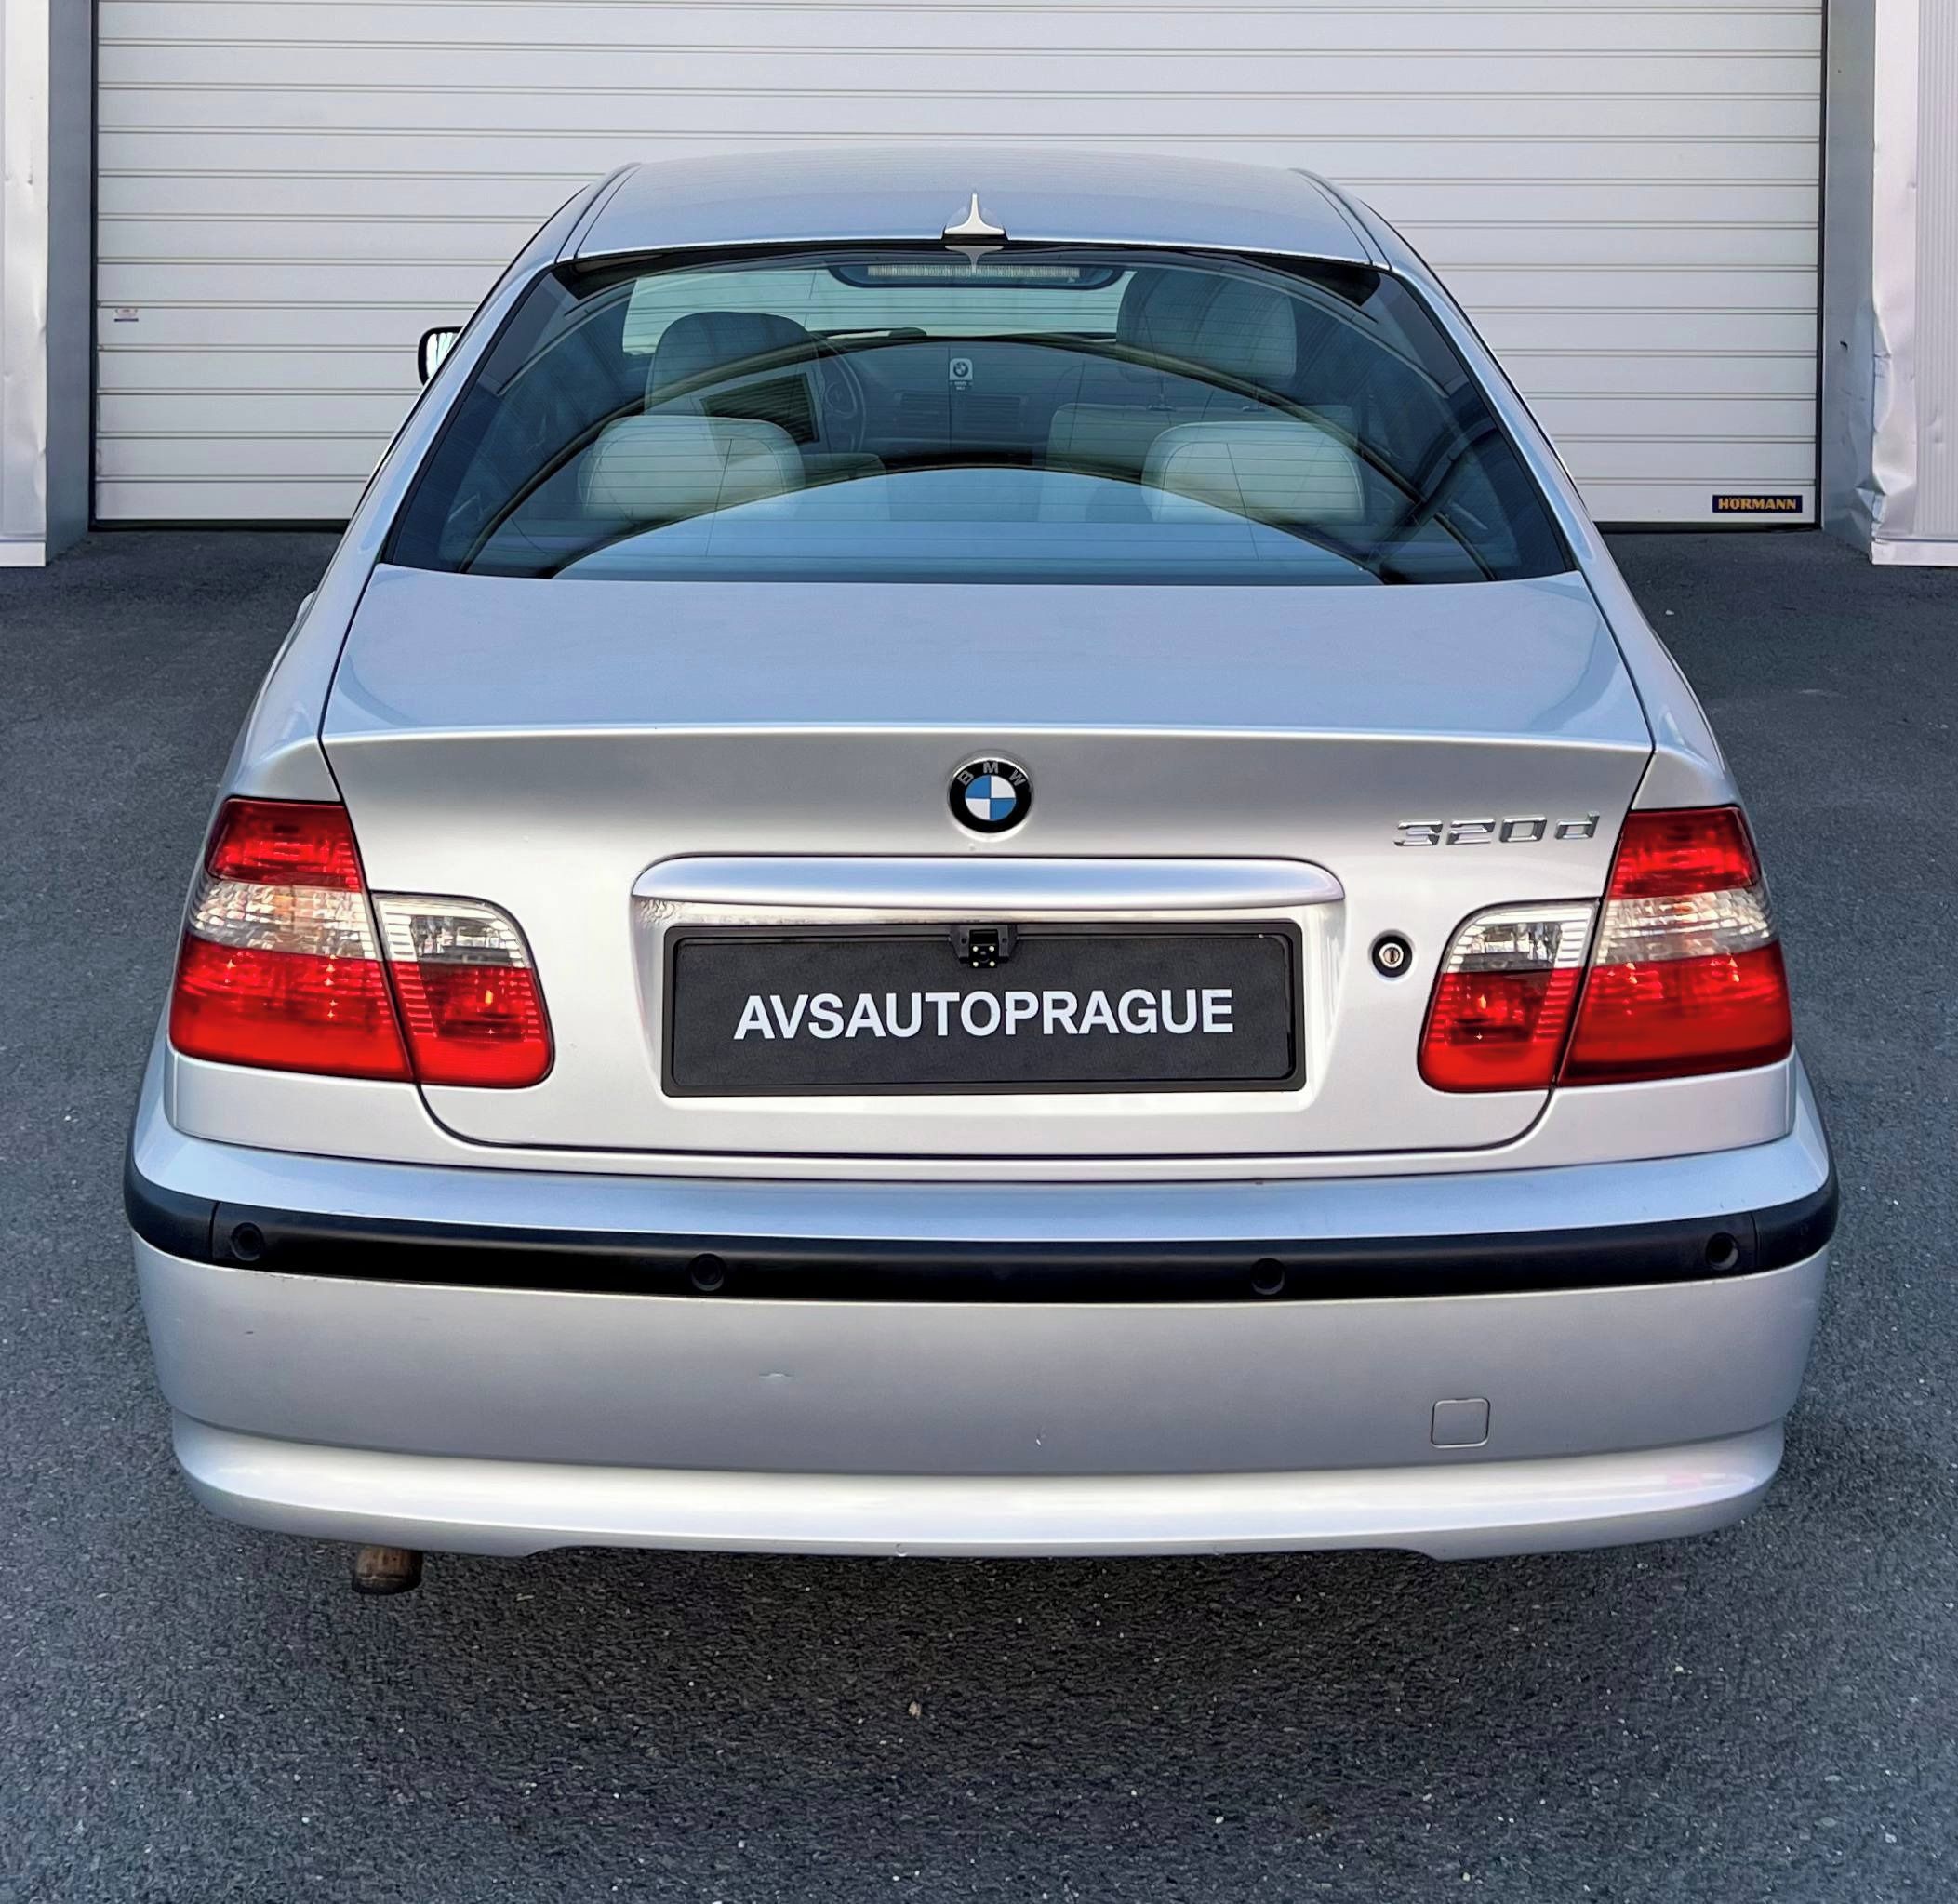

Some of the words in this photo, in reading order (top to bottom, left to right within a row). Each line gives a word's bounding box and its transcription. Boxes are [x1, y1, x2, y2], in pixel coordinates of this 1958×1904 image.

[956, 761, 1027, 787] BMW
[1393, 810, 1600, 846] 320d
[733, 988, 1234, 1041] AVSAUTOPRAGUE
